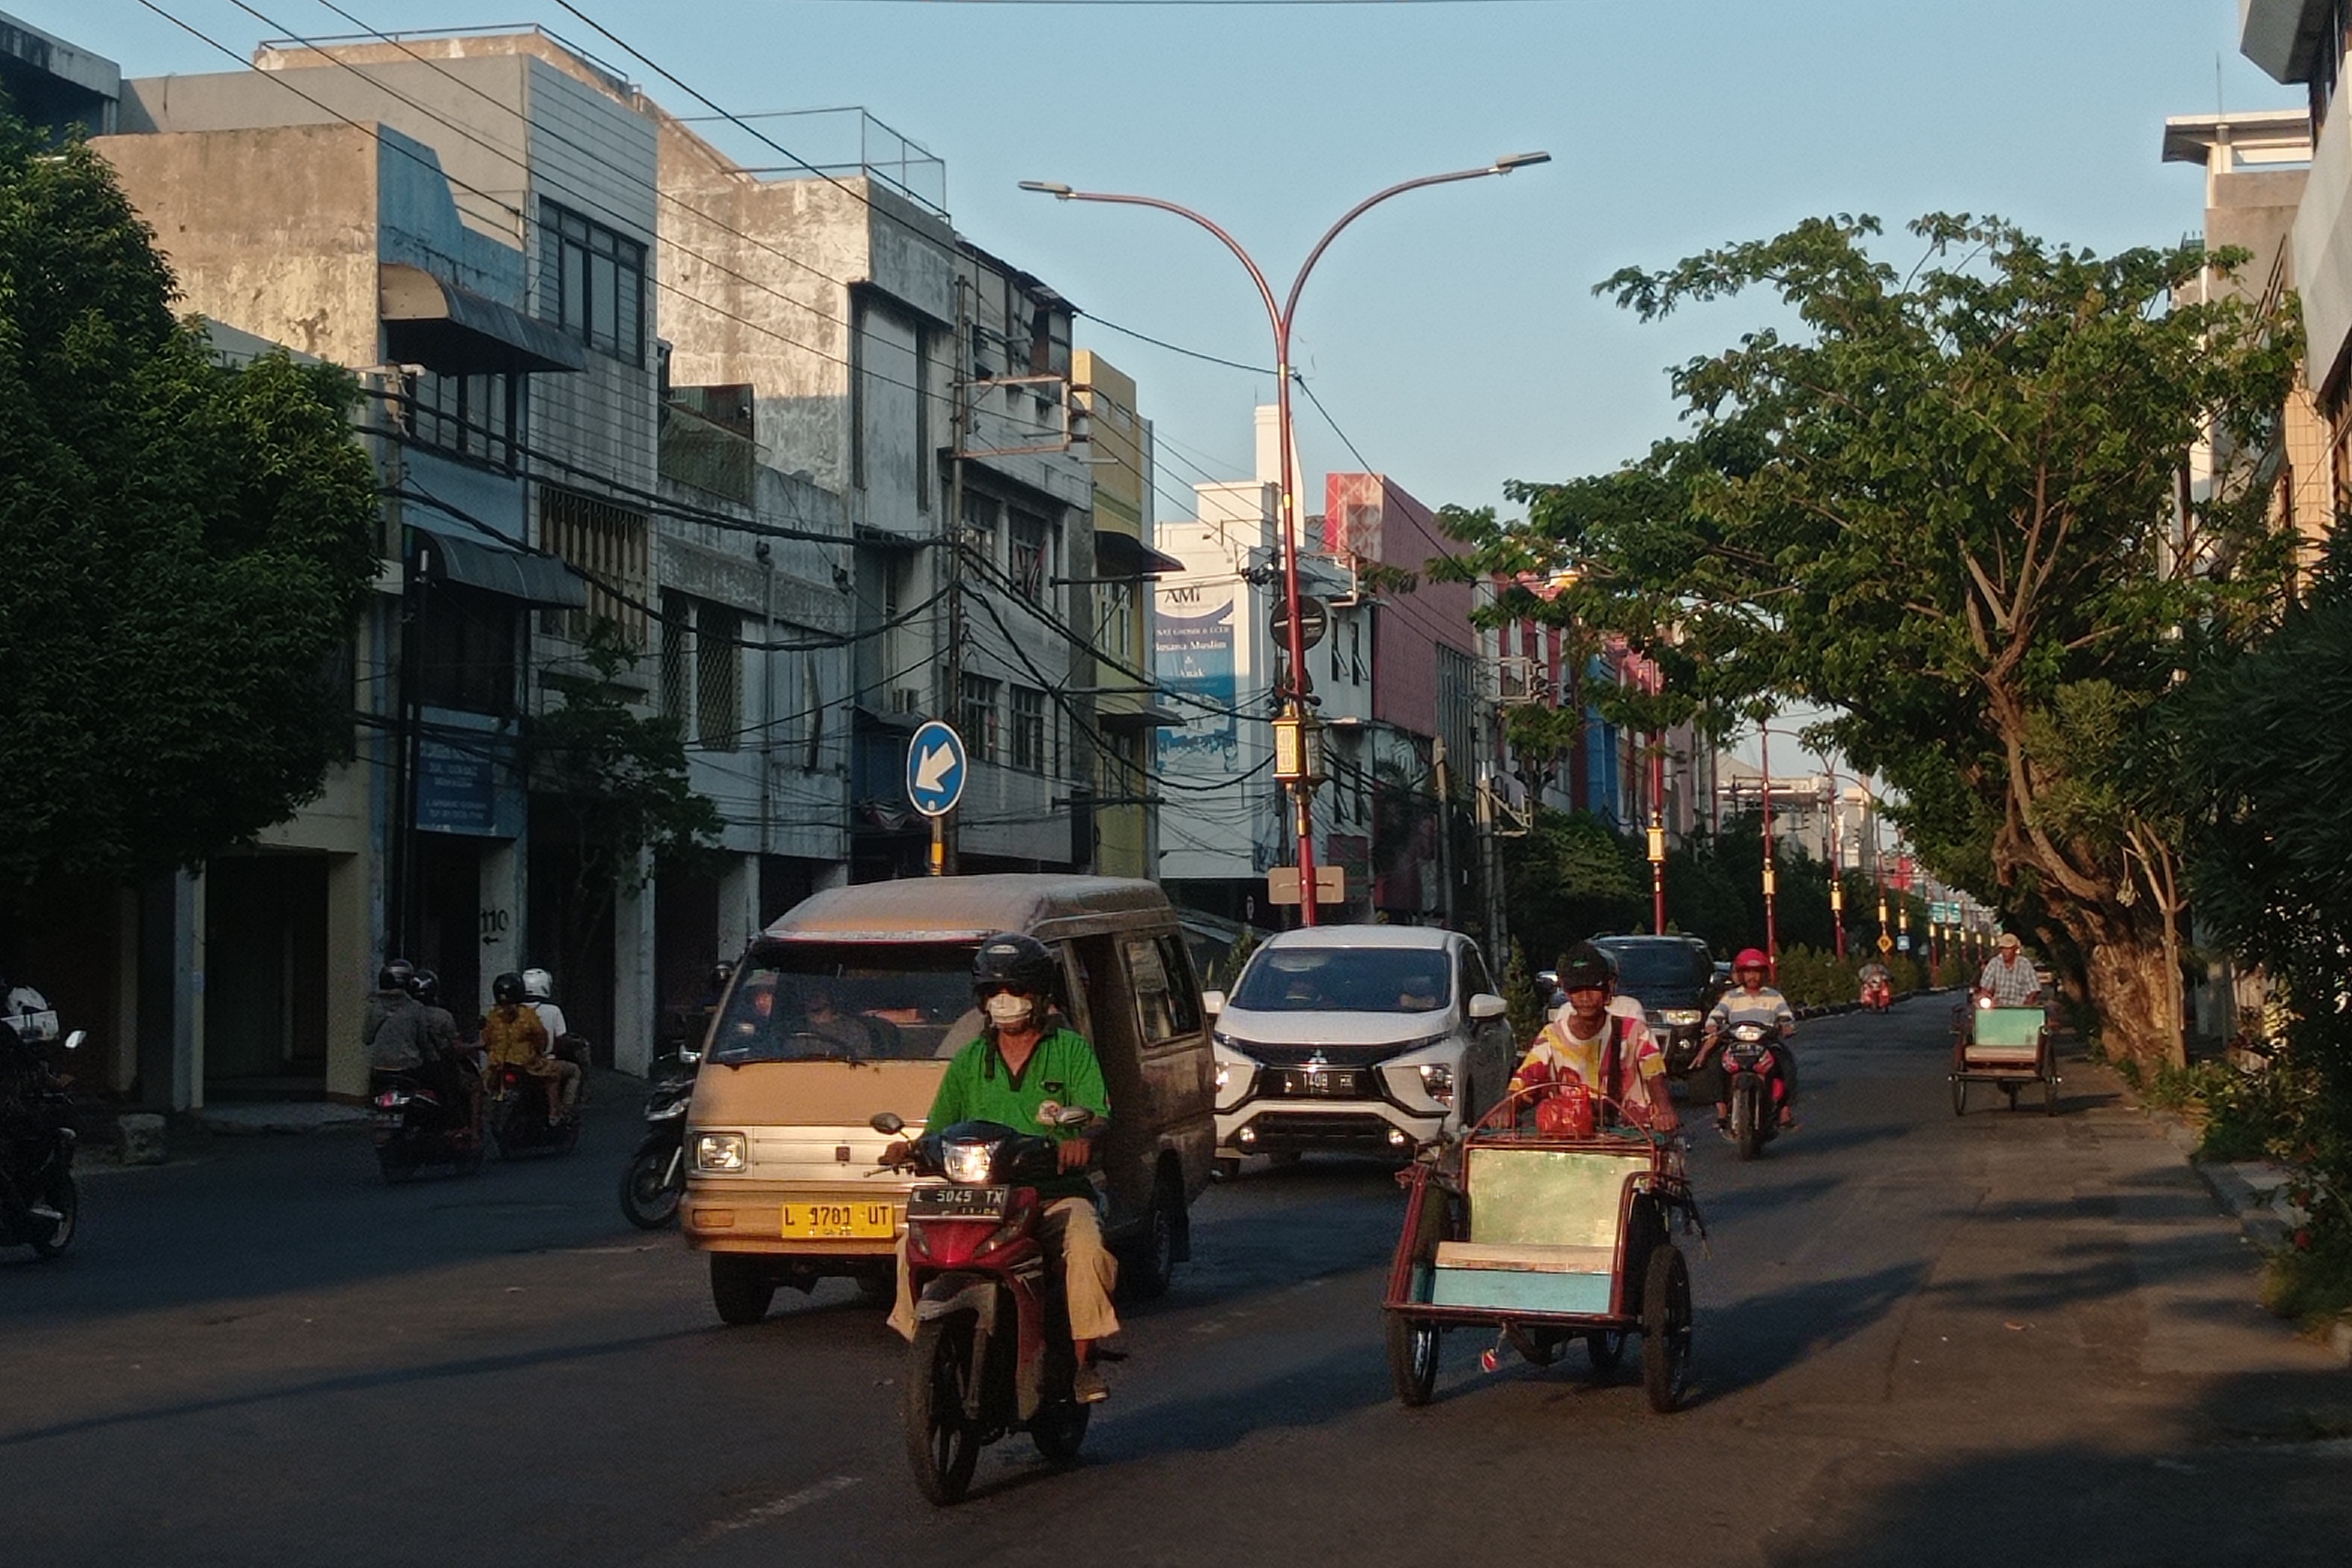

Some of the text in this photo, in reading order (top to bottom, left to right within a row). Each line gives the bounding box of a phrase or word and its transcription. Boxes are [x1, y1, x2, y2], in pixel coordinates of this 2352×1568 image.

[1190, 640, 1227, 650] Muslim
[481, 909, 509, 932] 110
[986, 1190, 1004, 1204] TX
[785, 1205, 889, 1226] L 1781 UT
